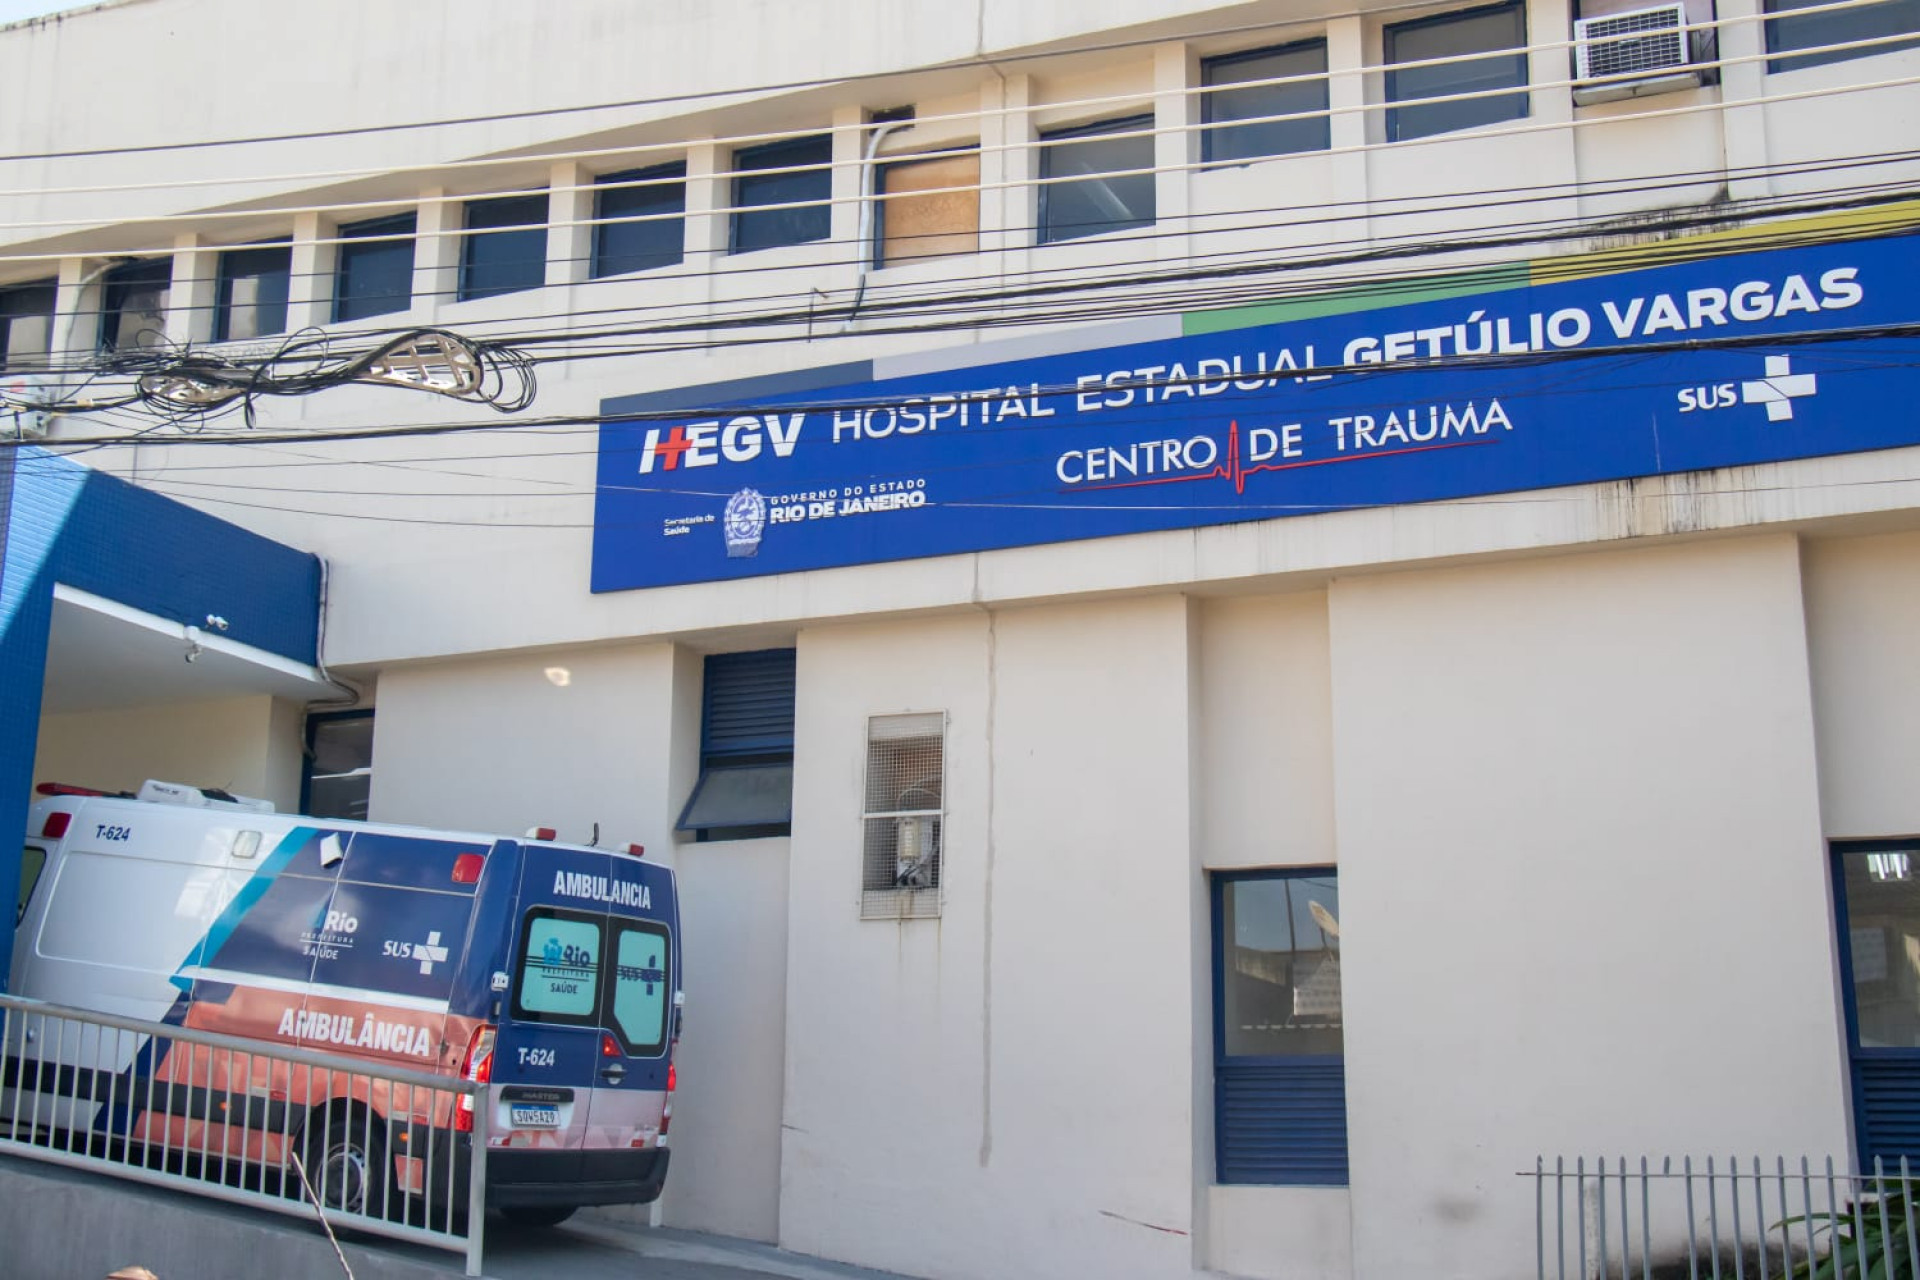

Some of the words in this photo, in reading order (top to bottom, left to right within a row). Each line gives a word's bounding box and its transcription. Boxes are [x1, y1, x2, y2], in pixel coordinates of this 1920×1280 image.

[833, 383, 1055, 443] HOSPITAL
[1077, 345, 1332, 411] ESTADUAL
[1344, 308, 1591, 374] GETÚLIO
[1601, 267, 1864, 338] VARGAS
[1678, 383, 1737, 412] SUS
[1056, 435, 1217, 483] CENTRO
[1249, 424, 1302, 462] DE
[1328, 397, 1513, 450] TRAUMA
[770, 488, 838, 505] GOVERNO
[844, 485, 863, 496] DO
[870, 478, 926, 494] ESTADO
[704, 513, 715, 522] de
[770, 504, 802, 524] RIO
[808, 501, 836, 519] DE
[838, 490, 926, 516] JANEIRO
[96, 825, 131, 842] T-624
[324, 911, 358, 933] Rio
[382, 940, 412, 958] SUS
[563, 944, 590, 966] Rio
[551, 981, 578, 994] SAÚDE
[278, 1008, 430, 1057] AMBULÂNCIA
[518, 1047, 555, 1066] T-624
